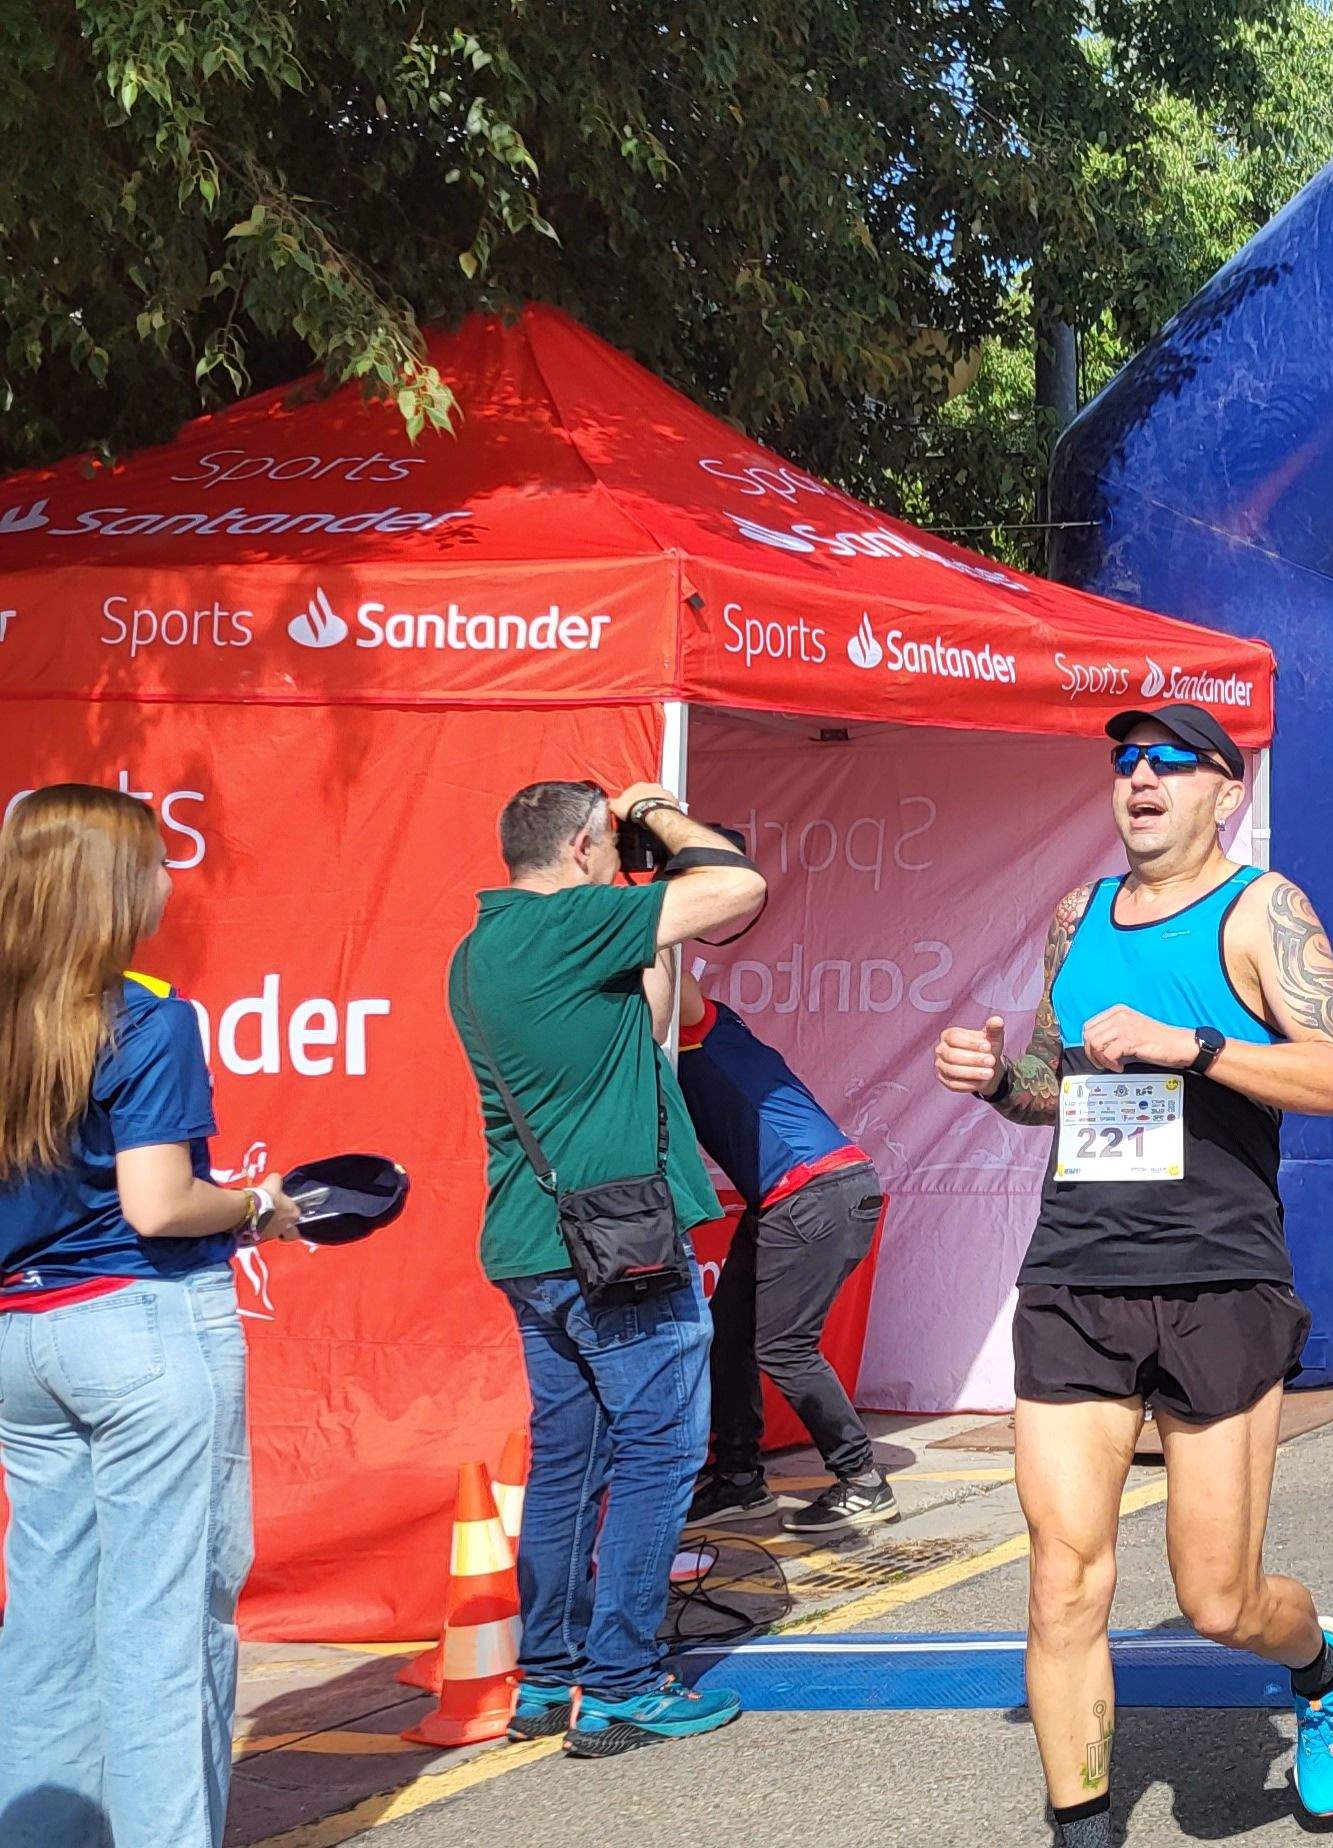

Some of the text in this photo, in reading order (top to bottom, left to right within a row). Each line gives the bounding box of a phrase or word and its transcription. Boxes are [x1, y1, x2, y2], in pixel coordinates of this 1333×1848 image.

[171, 449, 426, 489] Sports
[48, 506, 474, 538] Santander
[101, 595, 611, 657] Sports Santander
[723, 602, 1017, 684] Sports Santander
[1054, 652, 1254, 707] Sports Santander
[1076, 1126, 1145, 1158] 221
